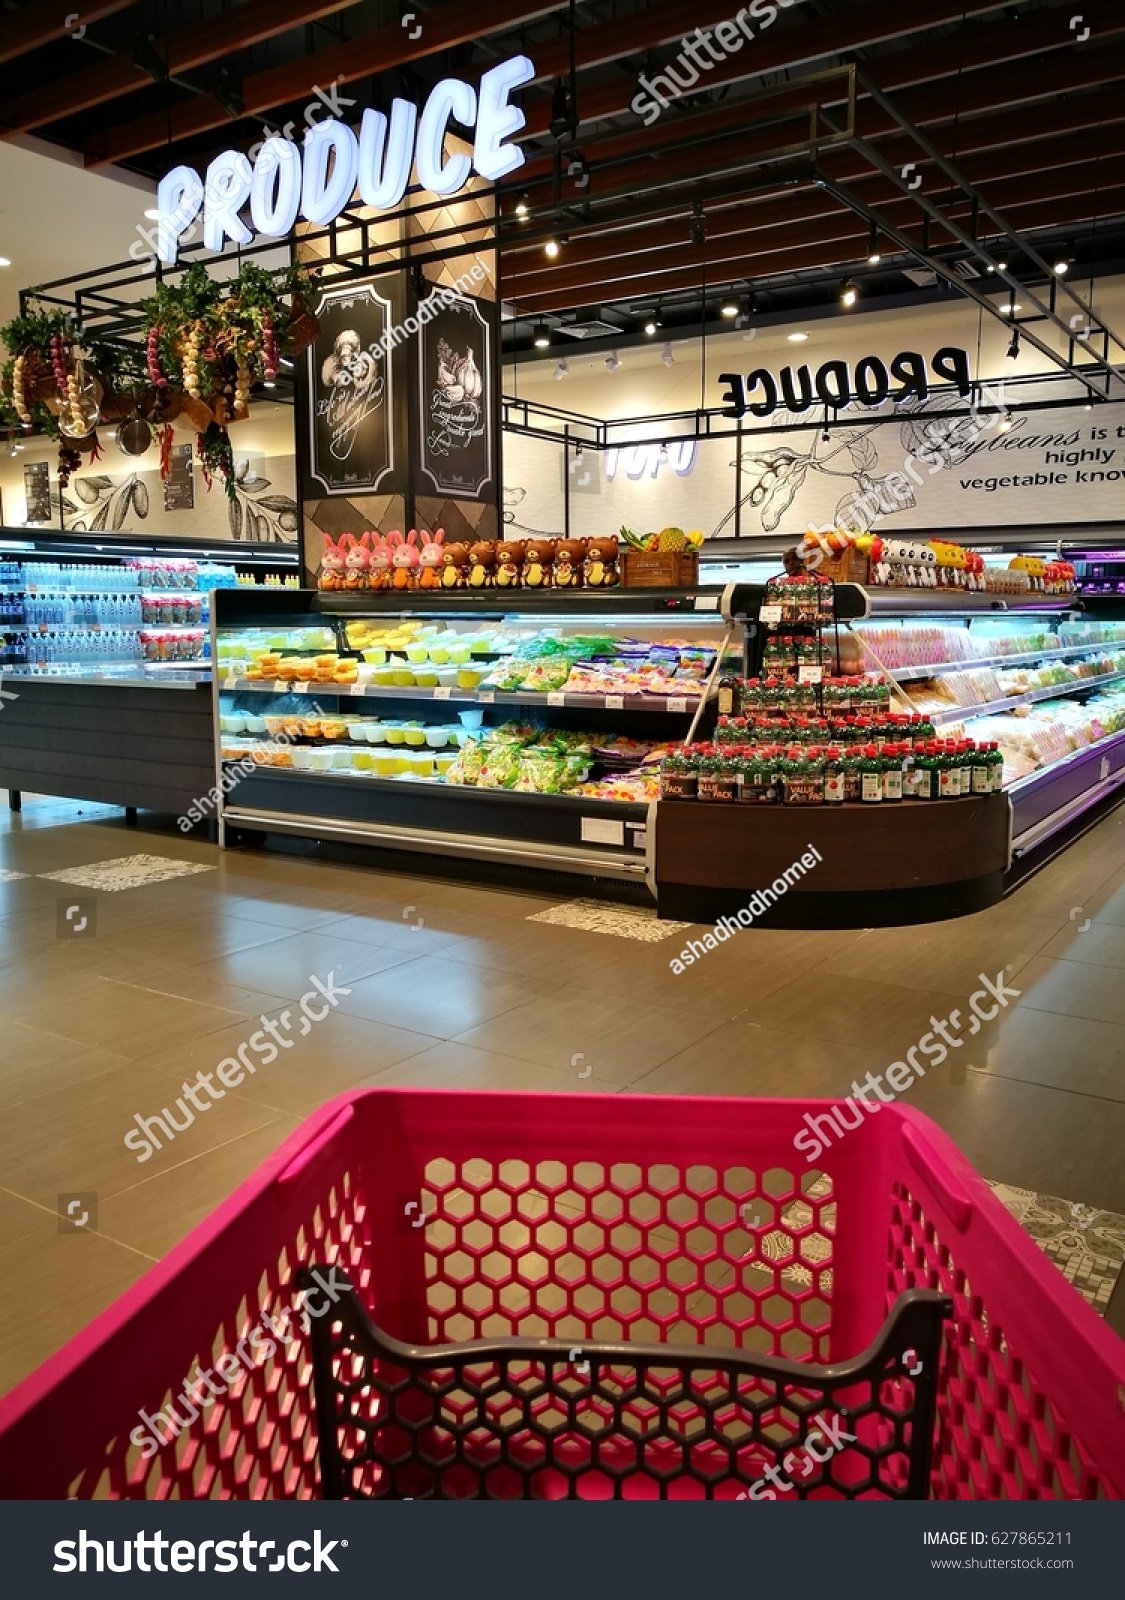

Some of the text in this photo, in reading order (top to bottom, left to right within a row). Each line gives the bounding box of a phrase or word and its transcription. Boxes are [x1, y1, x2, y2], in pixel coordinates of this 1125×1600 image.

[157, 54, 536, 264] PRODUCE
[1091, 427, 1108, 440] is
[1045, 447, 1116, 467] highly
[960, 471, 1061, 491] vegetable
